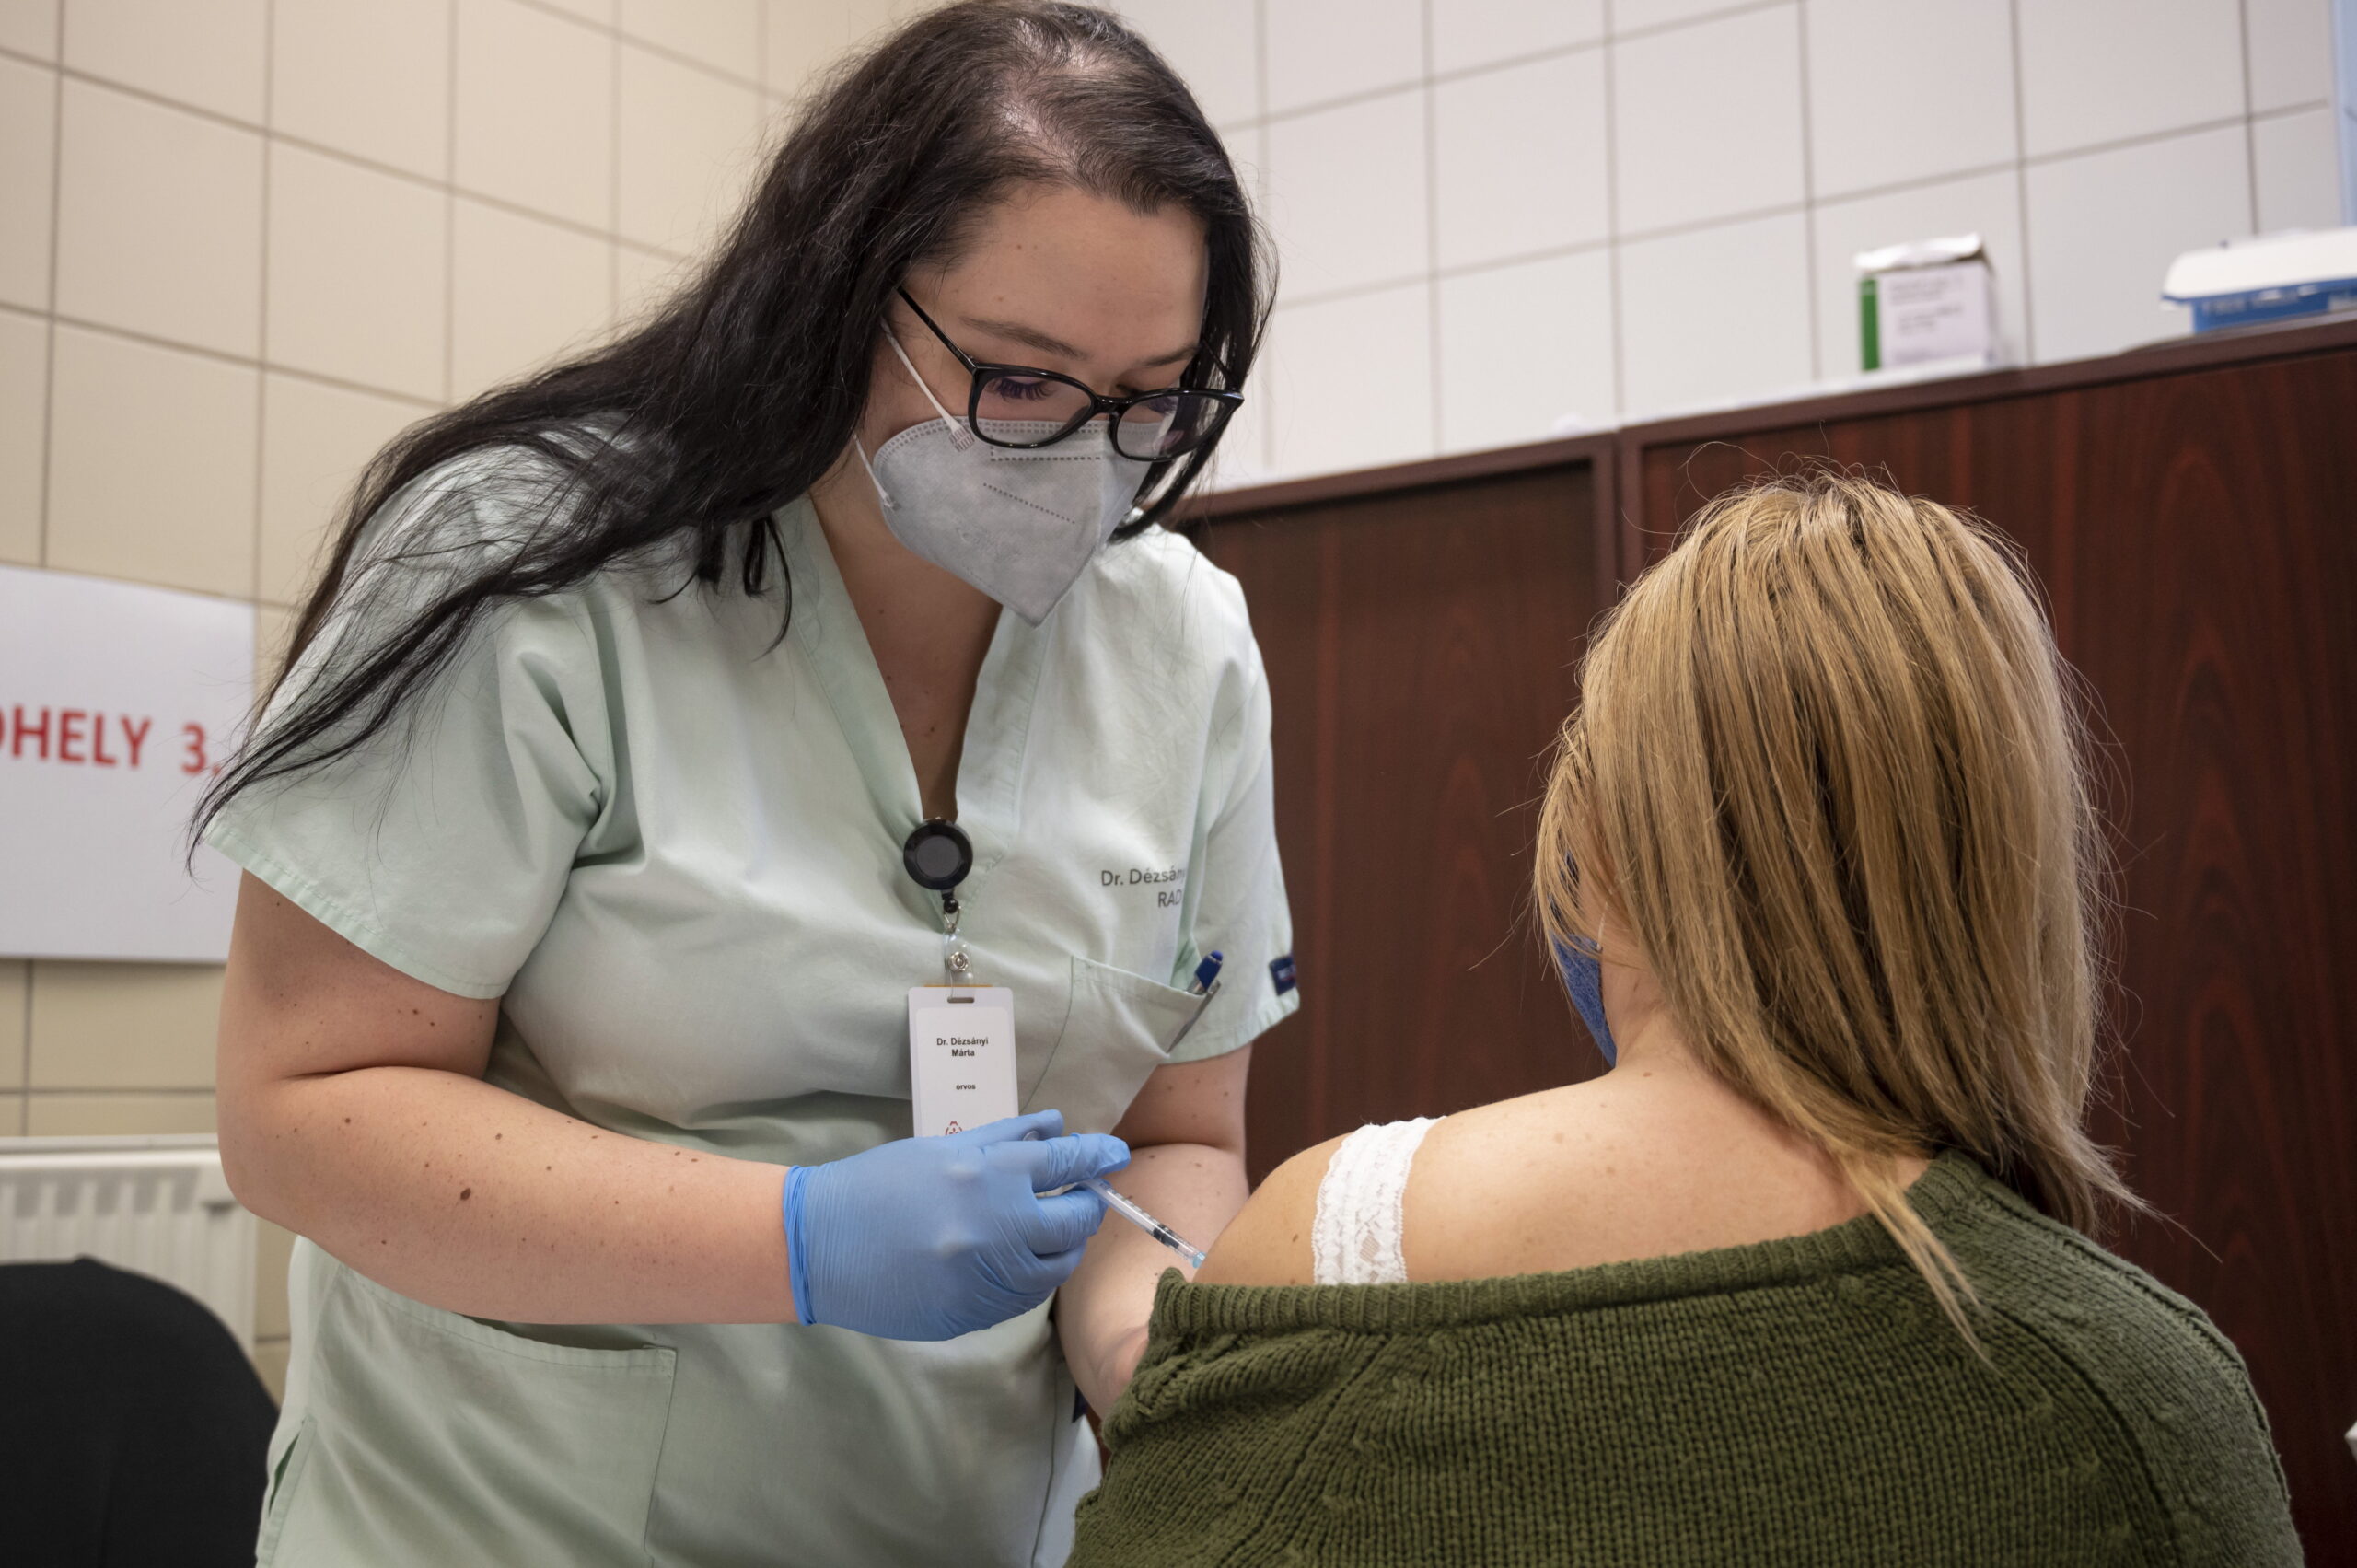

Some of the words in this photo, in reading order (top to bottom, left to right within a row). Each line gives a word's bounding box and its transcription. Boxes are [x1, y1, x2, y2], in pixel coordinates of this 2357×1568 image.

[0, 704, 152, 769] HELY
[180, 722, 222, 775] 3.
[1102, 870, 1124, 886] Dr.
[936, 1037, 948, 1046] Dr.
[950, 1036, 989, 1047] Dézsányi
[951, 1048, 975, 1057] Márta
